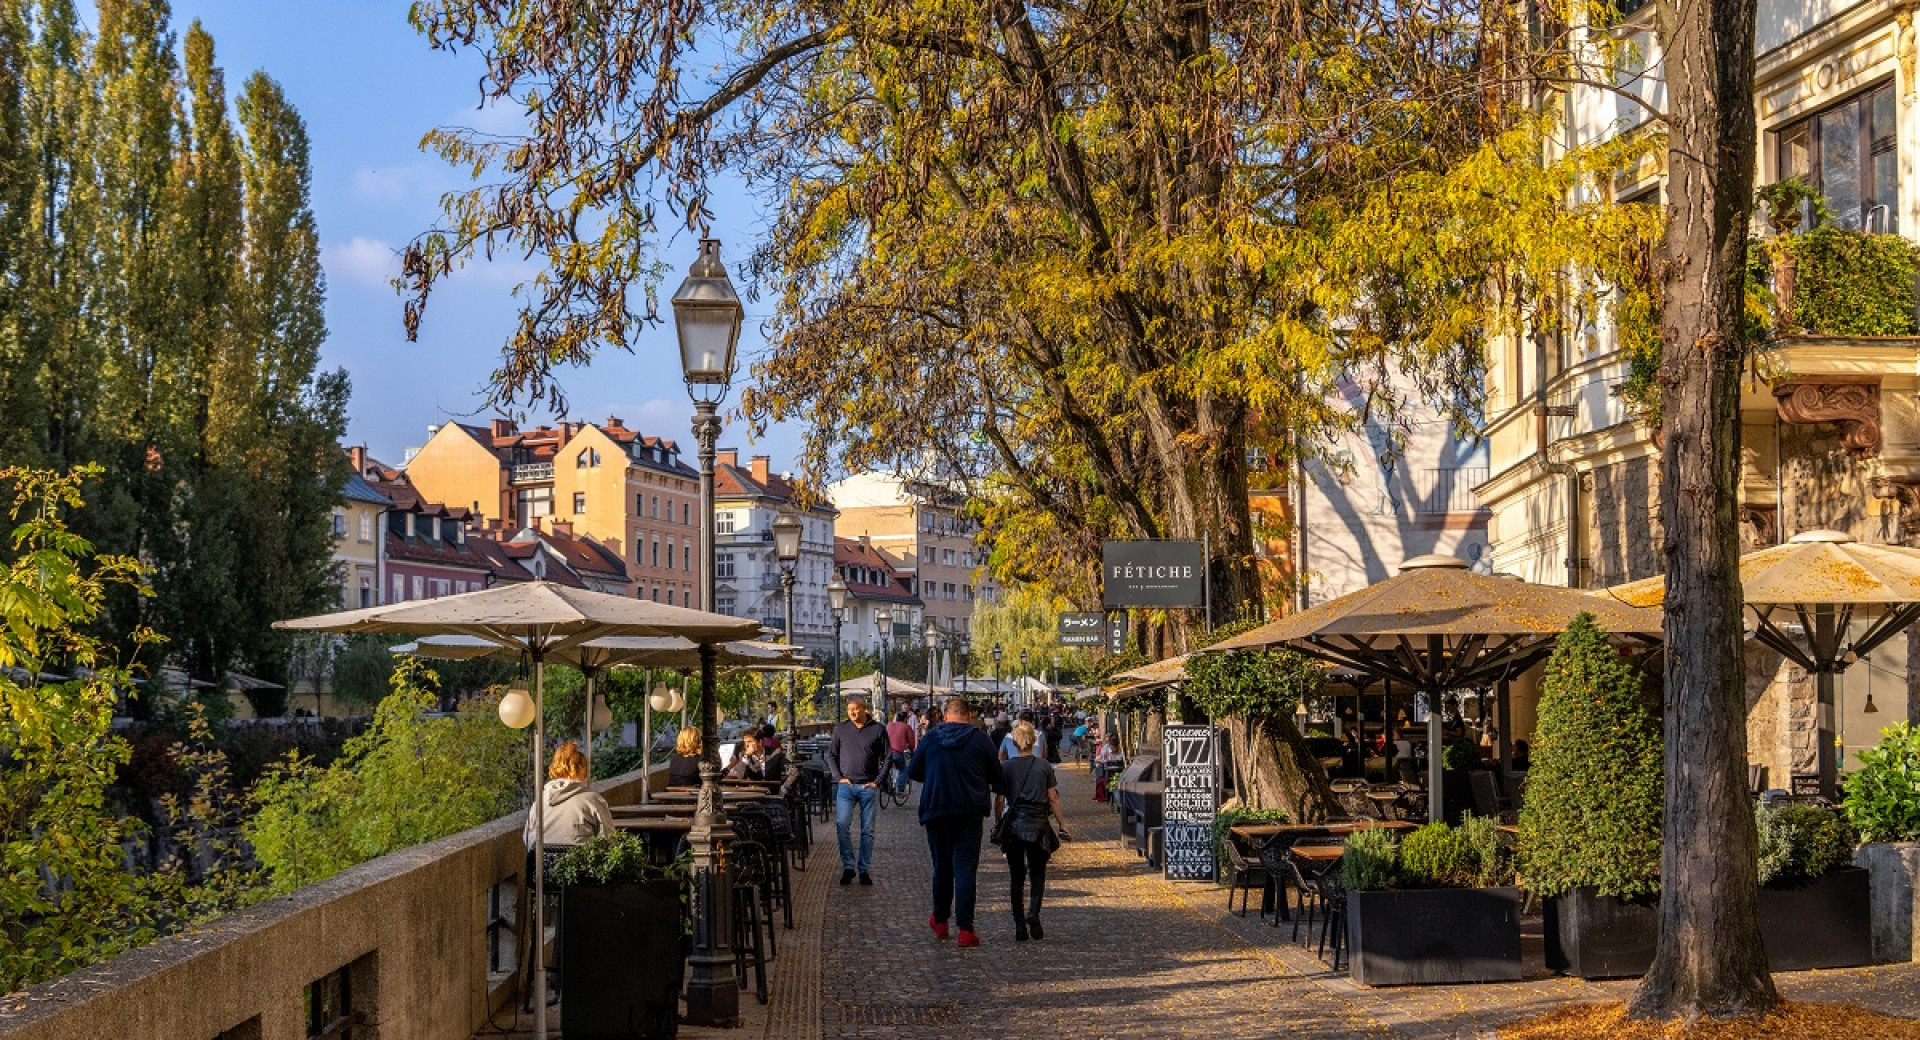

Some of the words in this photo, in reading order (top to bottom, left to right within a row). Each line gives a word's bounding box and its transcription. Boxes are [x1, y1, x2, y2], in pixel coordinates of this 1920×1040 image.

[1113, 561, 1193, 579] FÉTICHE
[1063, 618, 1099, 628] ラーメン
[1086, 635, 1099, 643] BAR
